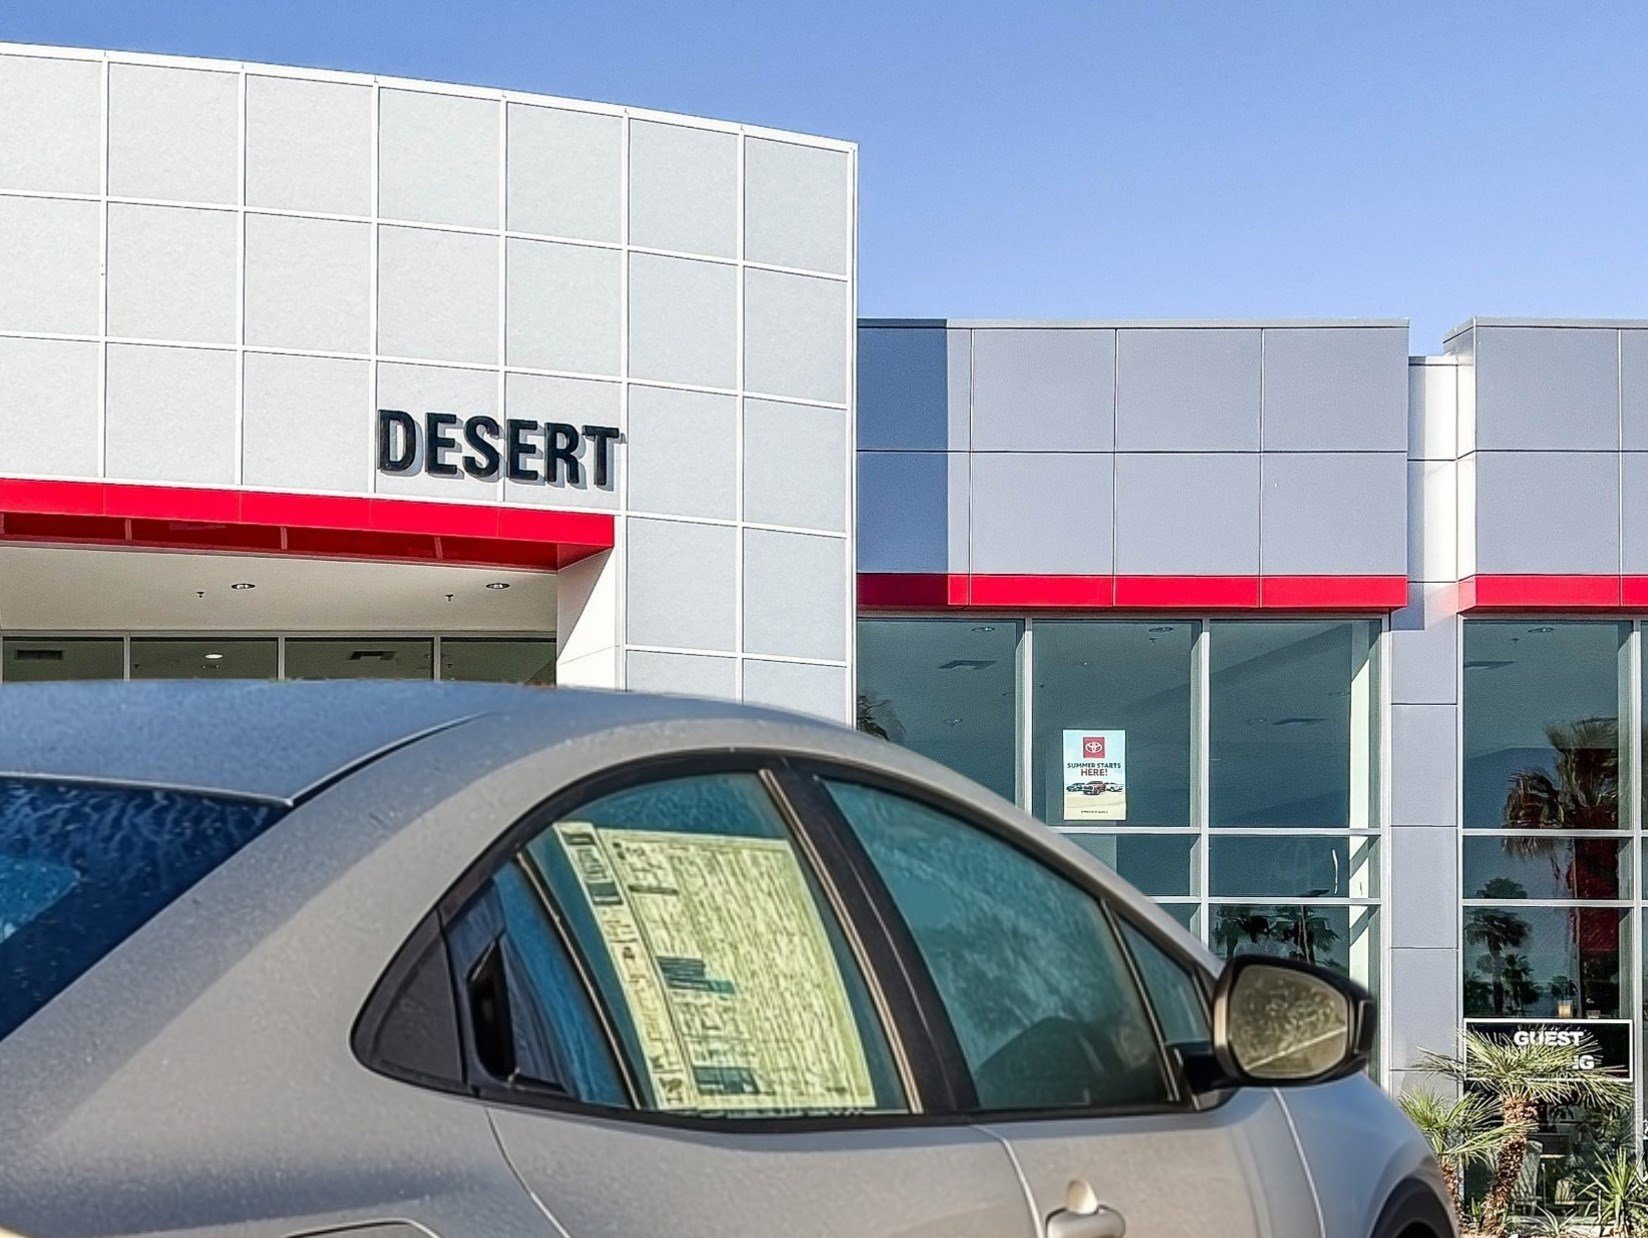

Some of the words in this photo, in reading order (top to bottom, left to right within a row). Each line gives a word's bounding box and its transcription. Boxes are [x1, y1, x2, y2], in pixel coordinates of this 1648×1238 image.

[377, 408, 621, 488] DESERT
[1080, 768, 1108, 776] HERE!
[1513, 1030, 1585, 1047] GUEST
